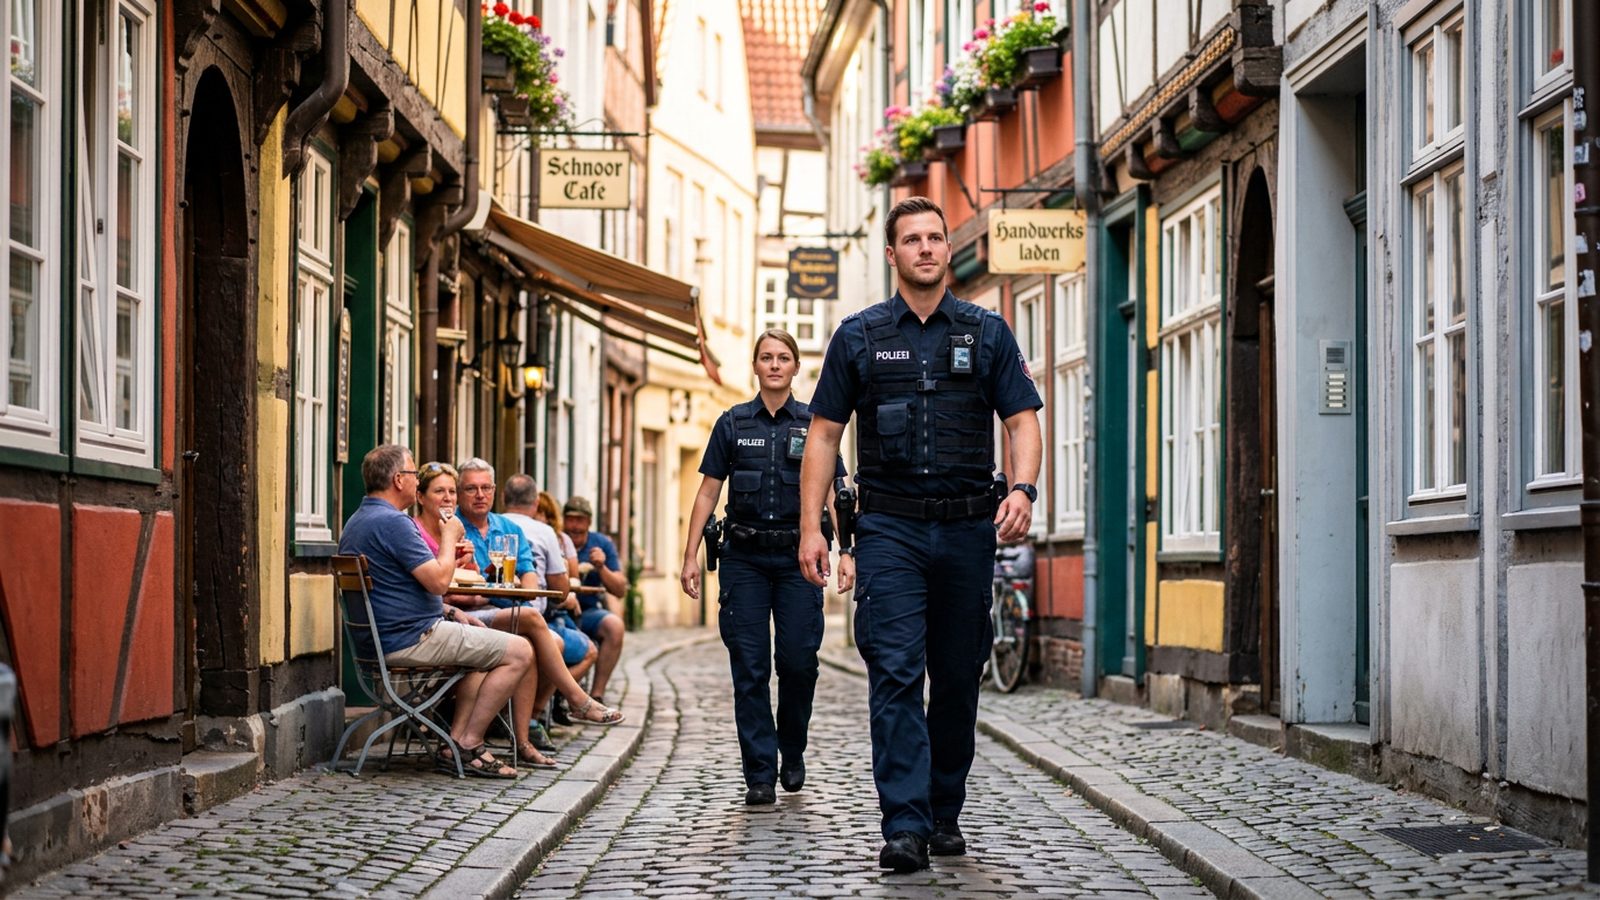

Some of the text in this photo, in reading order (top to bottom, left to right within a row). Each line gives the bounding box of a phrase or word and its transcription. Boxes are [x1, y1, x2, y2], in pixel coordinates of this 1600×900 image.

[547, 156, 623, 176] Schnoor
[564, 181, 606, 200] Cafe
[995, 221, 1084, 242] Handwerks
[1019, 243, 1060, 261] laden
